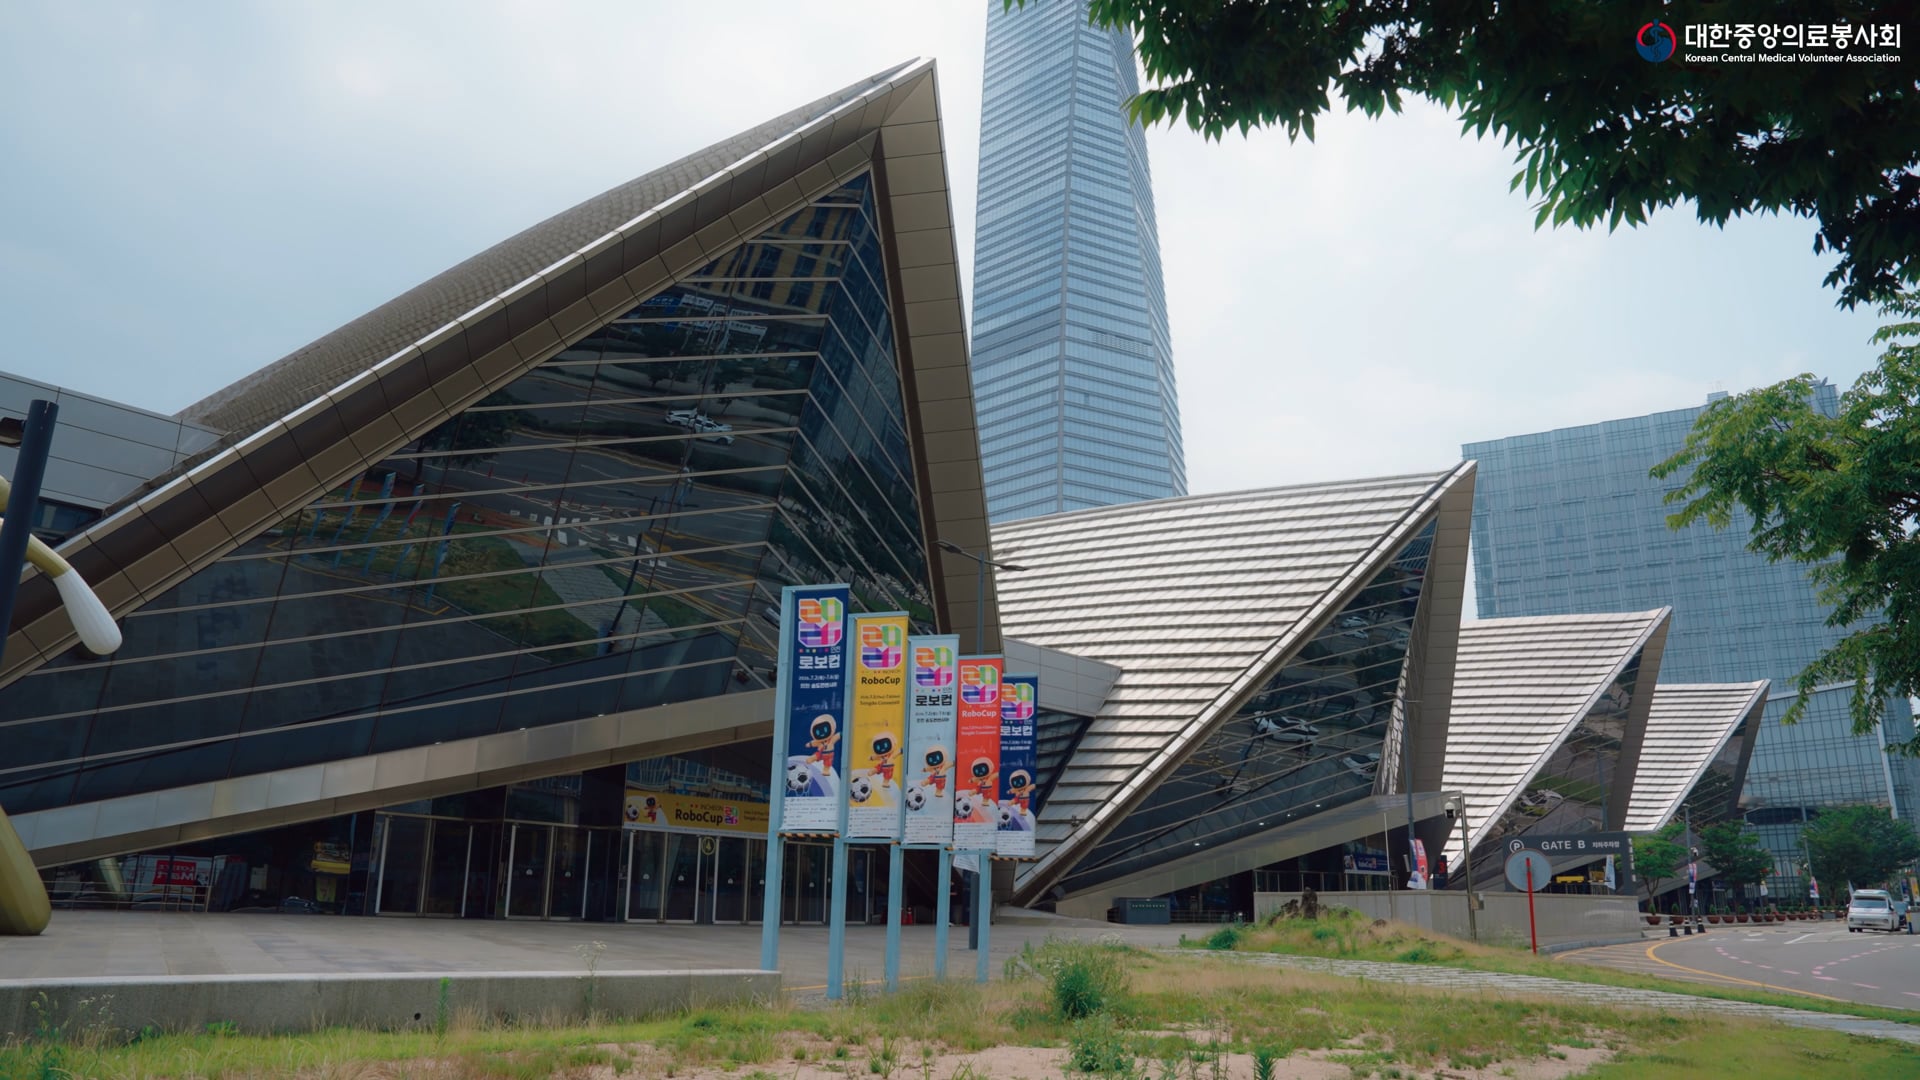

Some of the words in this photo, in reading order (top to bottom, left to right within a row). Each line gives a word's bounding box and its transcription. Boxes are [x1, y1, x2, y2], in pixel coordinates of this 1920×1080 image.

[798, 654, 841, 669] 로보컵
[861, 675, 901, 685] RoboCup
[915, 694, 953, 707] 로보컵
[961, 709, 997, 718] RoboCup
[1000, 725, 1033, 736] 로보컵
[675, 809, 723, 826] RoboCup
[1541, 840, 1572, 850] GATE
[1577, 840, 1586, 849] B
